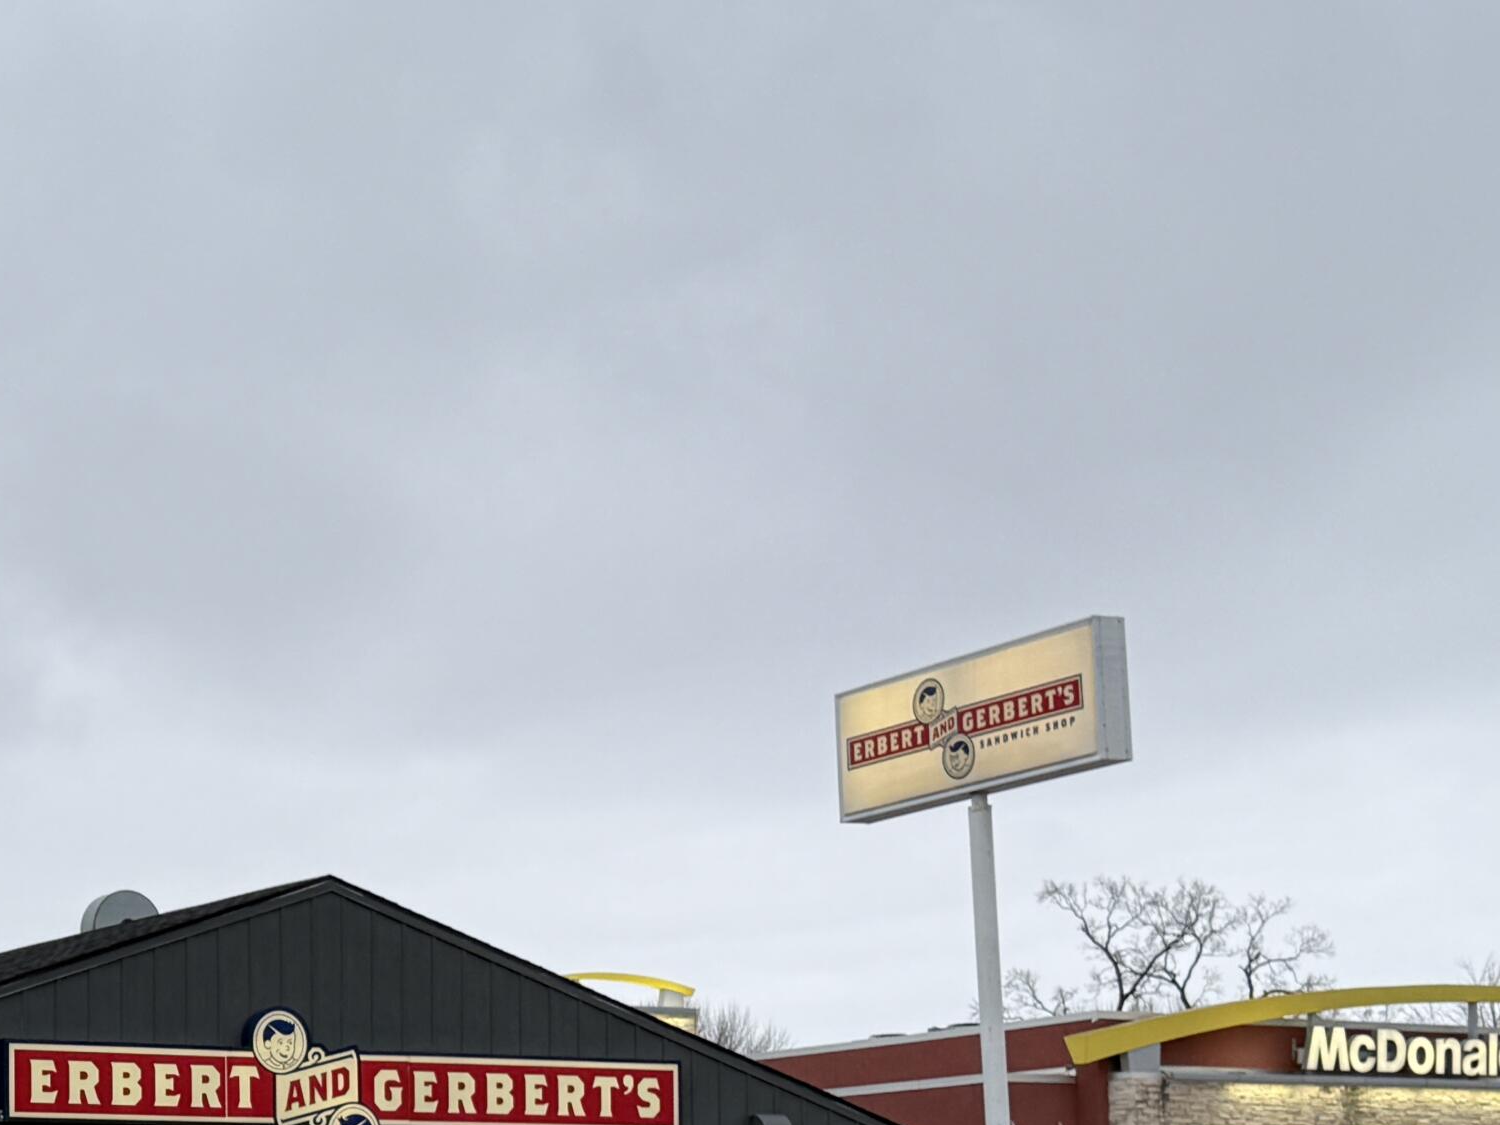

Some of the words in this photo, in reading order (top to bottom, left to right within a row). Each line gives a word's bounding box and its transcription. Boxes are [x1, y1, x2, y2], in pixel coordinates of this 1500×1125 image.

[853, 725, 924, 762] ERBERT
[932, 716, 955, 741] AND
[962, 684, 1075, 732] GERBERT'S
[980, 726, 1039, 749] SANDWICH
[1045, 716, 1076, 732] SHOP
[1306, 1025, 1500, 1077] McDonal
[29, 1058, 260, 1109] ERBERT
[285, 1066, 351, 1112] AND
[373, 1069, 662, 1119] GERBERT'S
